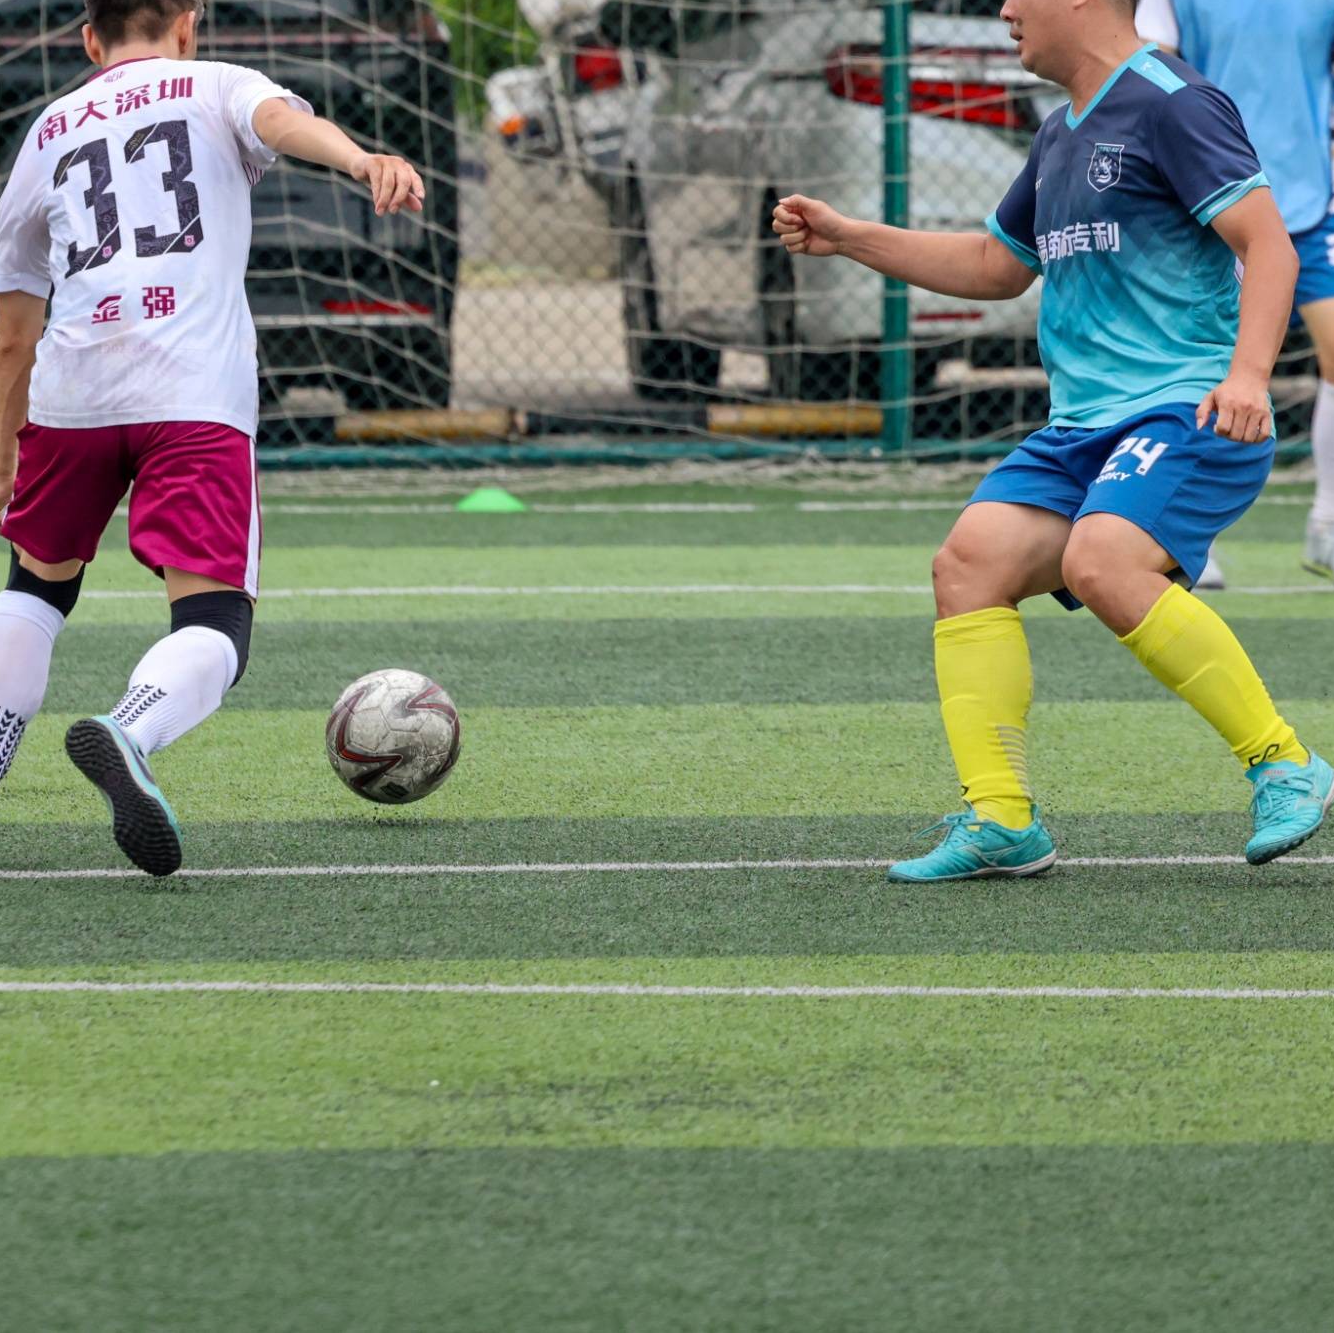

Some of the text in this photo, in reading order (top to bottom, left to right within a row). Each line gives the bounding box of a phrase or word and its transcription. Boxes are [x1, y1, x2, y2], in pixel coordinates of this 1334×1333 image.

[37, 76, 194, 151] 南大深圳
[53, 119, 204, 280] 33
[91, 286, 176, 324] 金强
[1100, 436, 1169, 476] 24
